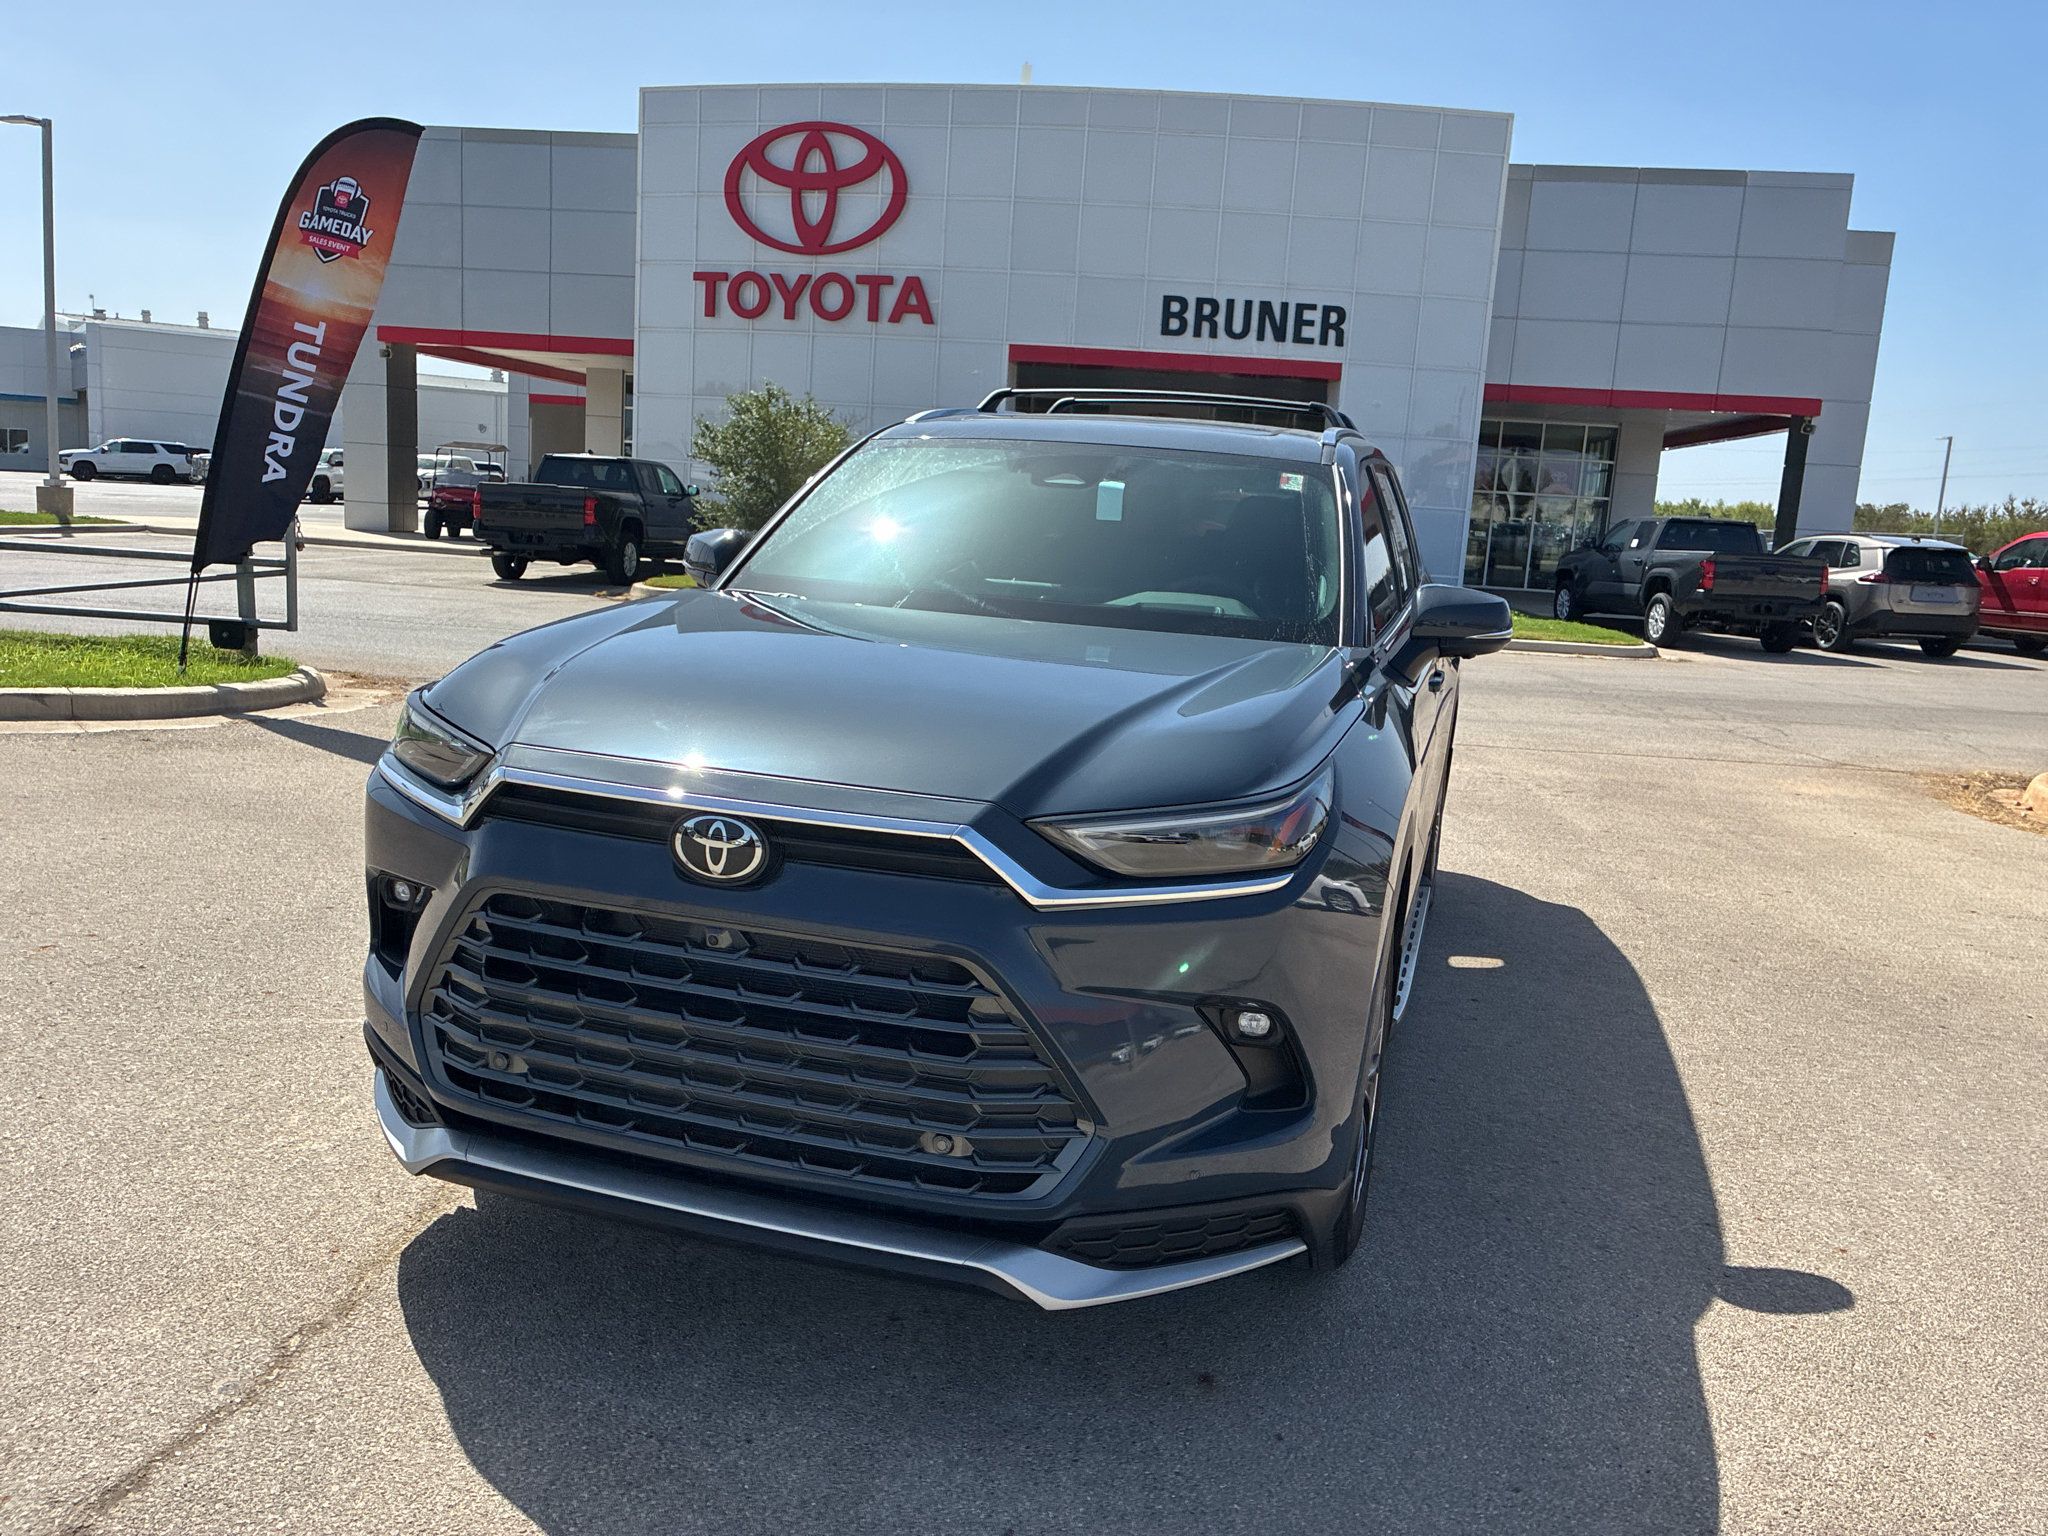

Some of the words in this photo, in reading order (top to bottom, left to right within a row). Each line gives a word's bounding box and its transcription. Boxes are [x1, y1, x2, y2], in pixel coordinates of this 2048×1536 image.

[299, 211, 374, 245] GAMEDAY
[308, 235, 328, 246] SALES
[328, 240, 351, 252] EVENT
[693, 271, 934, 324] TOYOTA
[1160, 295, 1347, 347] BRUNER
[261, 321, 327, 483] TUNDRA
